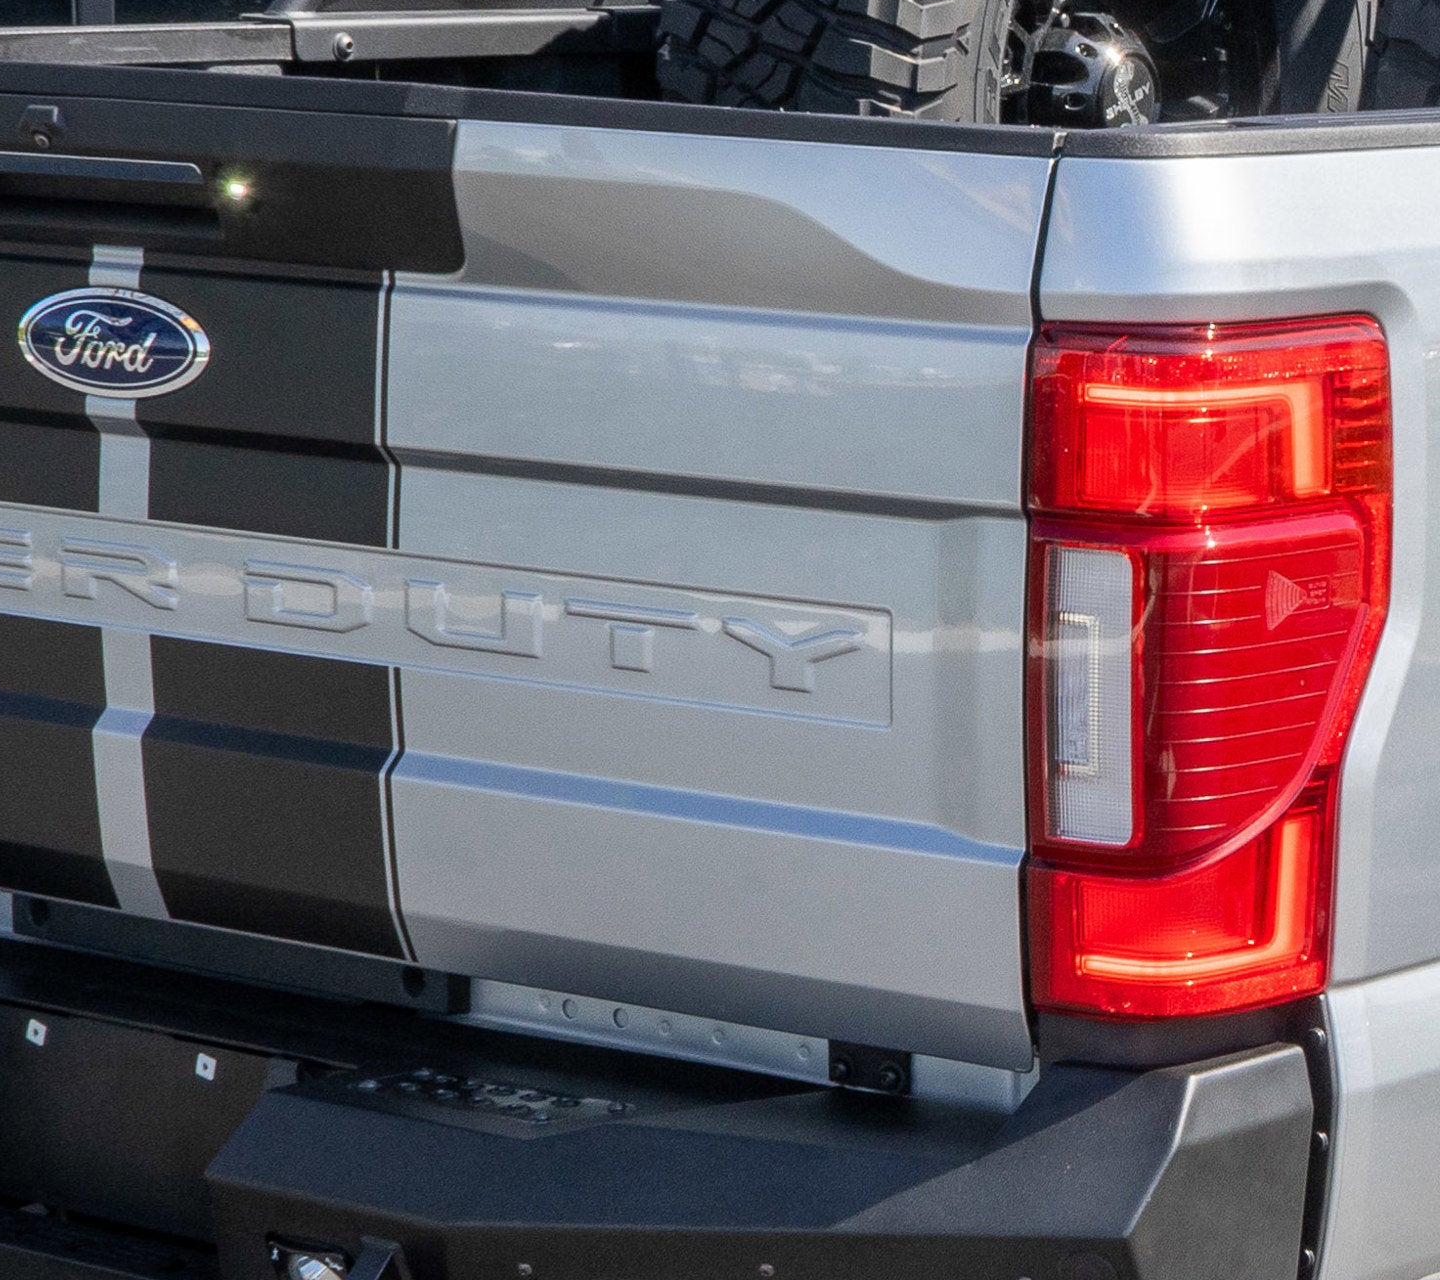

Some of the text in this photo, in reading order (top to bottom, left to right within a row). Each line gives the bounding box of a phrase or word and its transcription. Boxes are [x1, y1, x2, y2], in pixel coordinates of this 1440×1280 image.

[1105, 81, 1151, 120] SHLBY
[53, 309, 158, 374] Ford
[244, 559, 866, 693] DUTY
